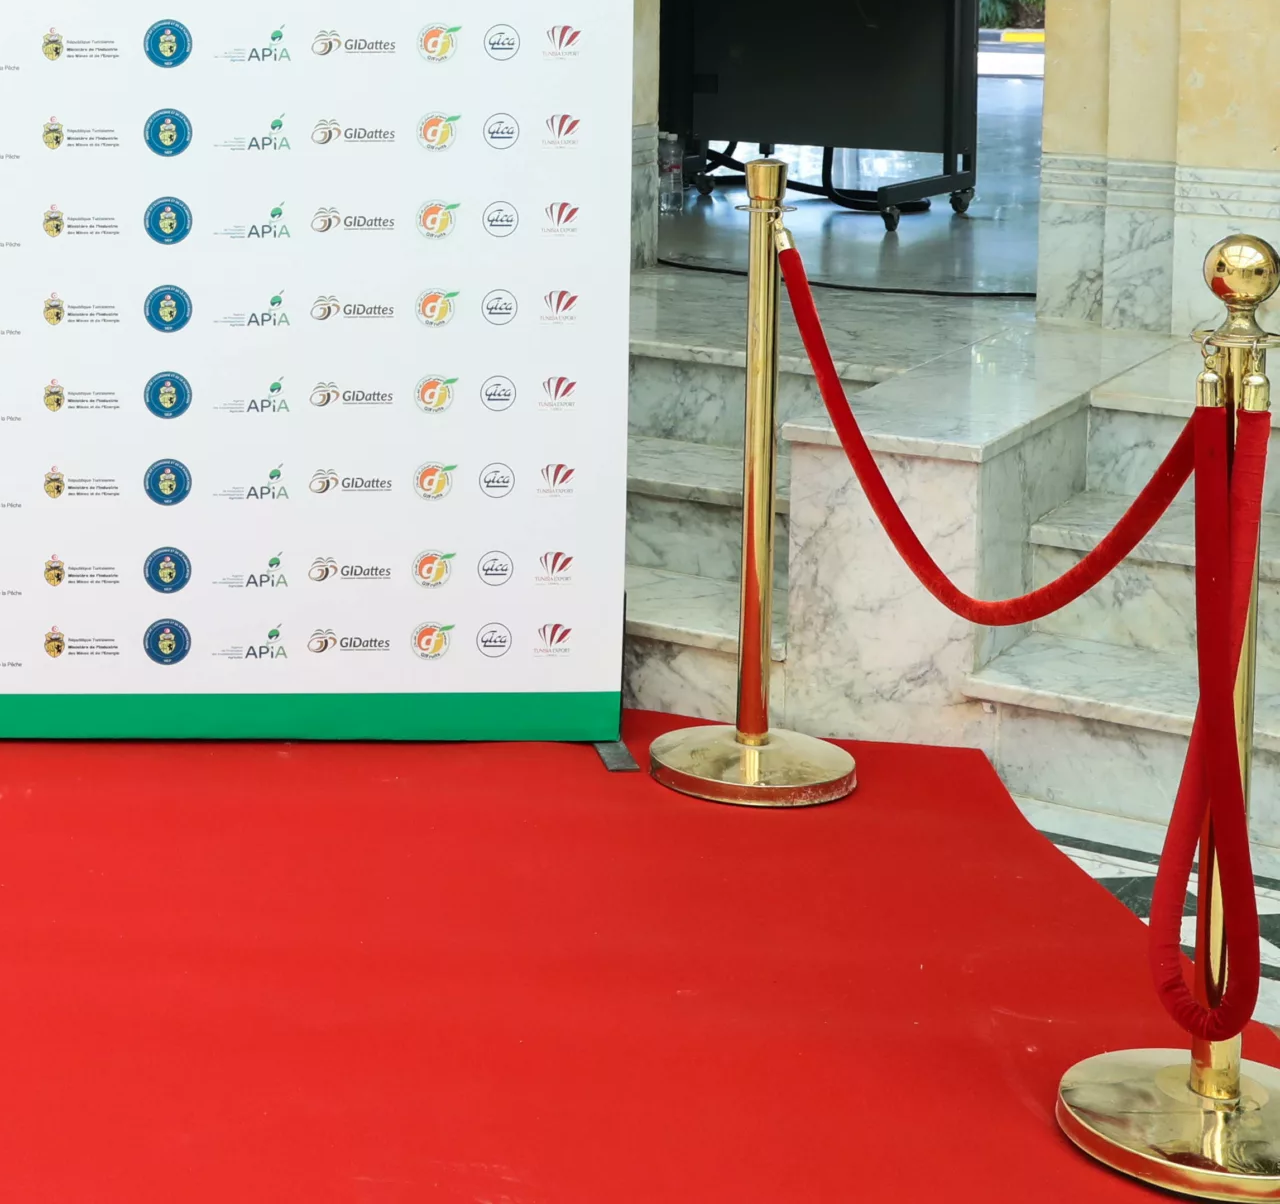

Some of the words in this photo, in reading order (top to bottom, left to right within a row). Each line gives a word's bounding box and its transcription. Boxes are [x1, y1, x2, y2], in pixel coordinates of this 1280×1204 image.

[344, 38, 396, 50] GIDattes
[343, 127, 396, 139] GIDattes
[343, 215, 395, 227] GIDattes
[342, 303, 395, 315] GIDattes
[342, 390, 394, 402] GIDattes
[341, 477, 393, 489] GIDattes
[340, 565, 391, 577] GIDattes
[339, 636, 390, 648] GIDattes
